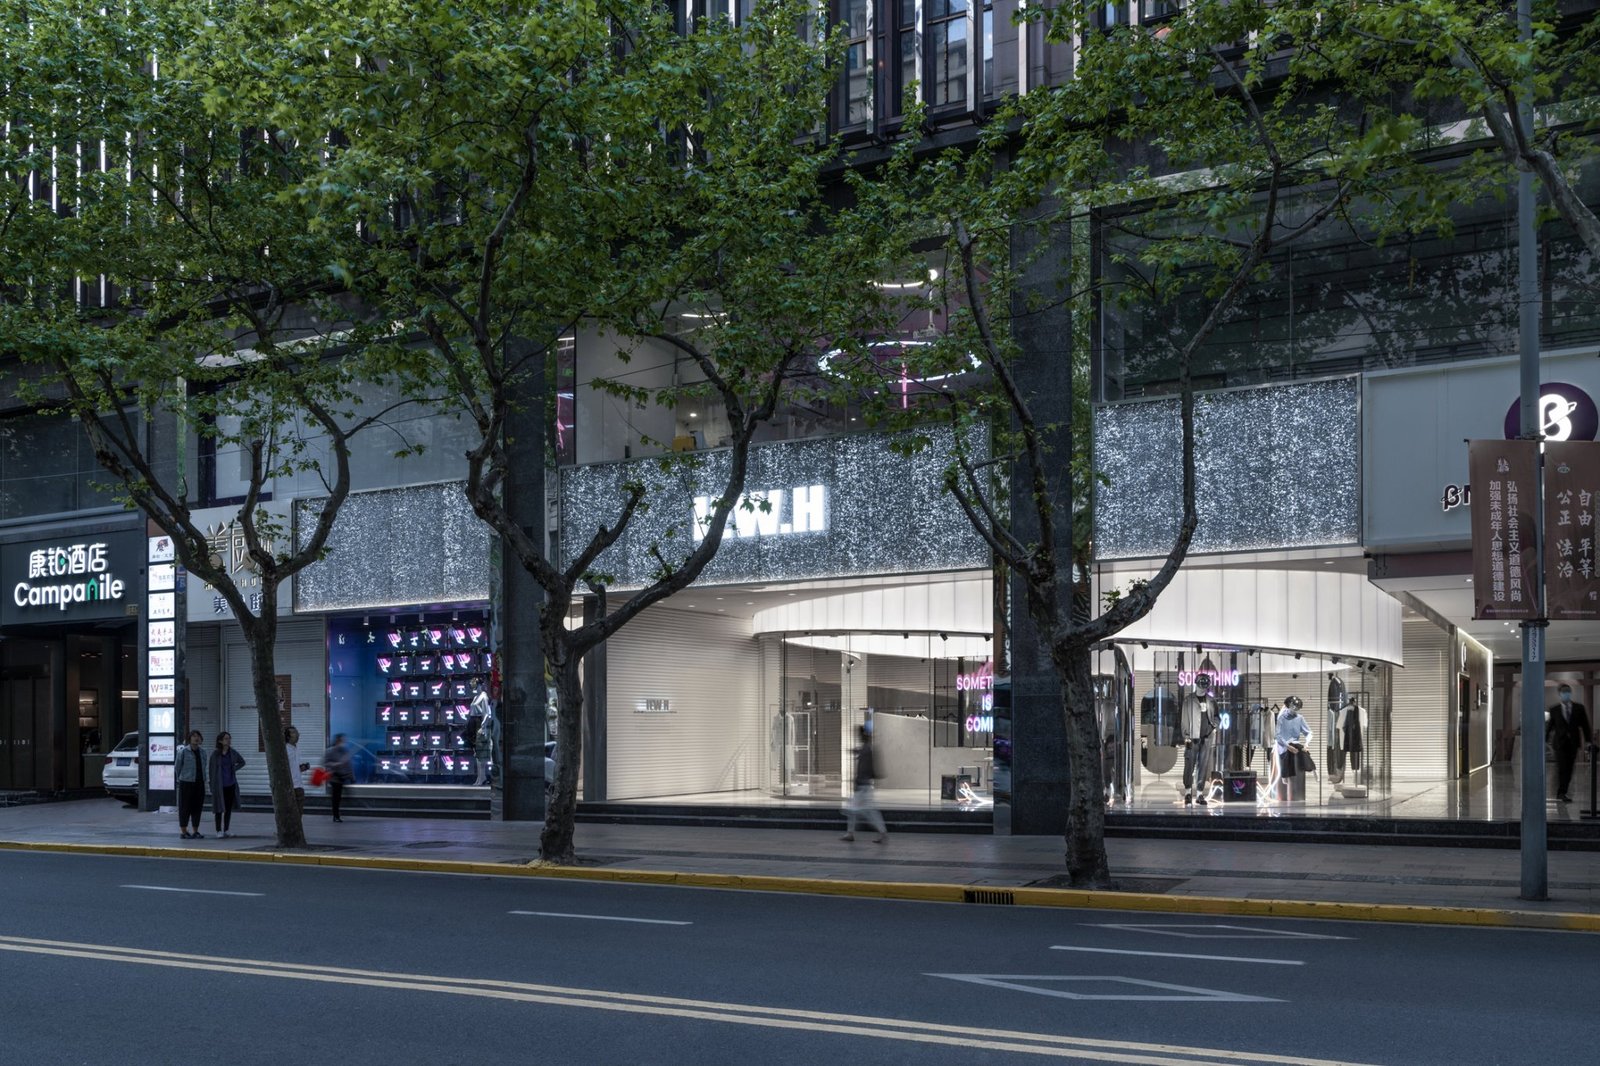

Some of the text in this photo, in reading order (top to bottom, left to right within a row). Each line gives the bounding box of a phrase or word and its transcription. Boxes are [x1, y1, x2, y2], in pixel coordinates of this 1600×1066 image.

[1556, 489, 1573, 526] 公正
[1577, 489, 1593, 526] 自由
[1489, 480, 1505, 602] 加强未成年人思想道德建设
[1506, 480, 1521, 602] 弘扬社会主义道德风尚
[1556, 538, 1574, 579] 法治
[29, 543, 108, 578] 康铂酒店
[14, 573, 124, 610] Campanile
[956, 675, 993, 690] SOMET
[1178, 670, 1239, 686] SOTHING
[981, 694, 992, 711] IS
